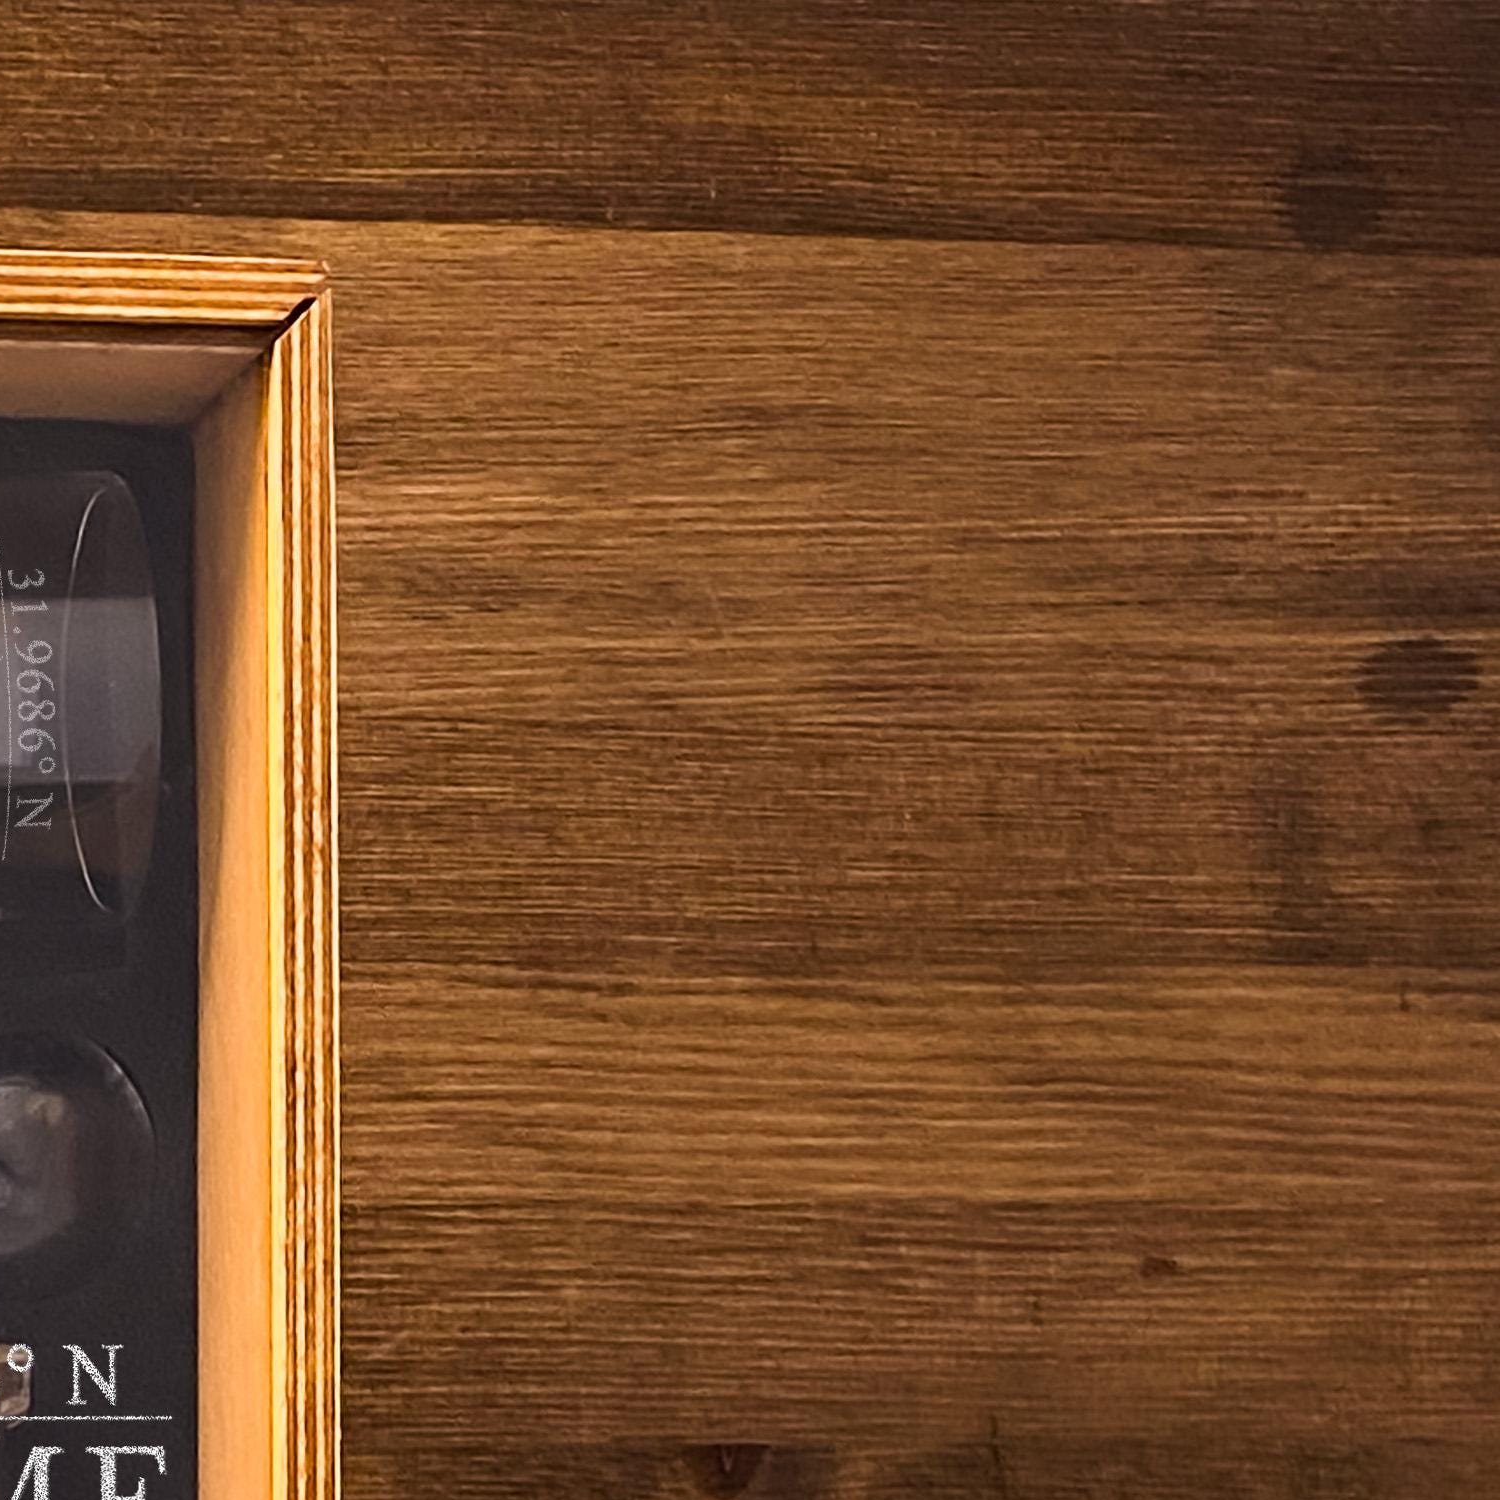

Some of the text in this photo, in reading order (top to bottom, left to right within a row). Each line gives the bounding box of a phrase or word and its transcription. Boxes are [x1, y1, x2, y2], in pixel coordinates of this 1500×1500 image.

[6, 567, 56, 830] 31.9686° N
[62, 1343, 125, 1406] N
